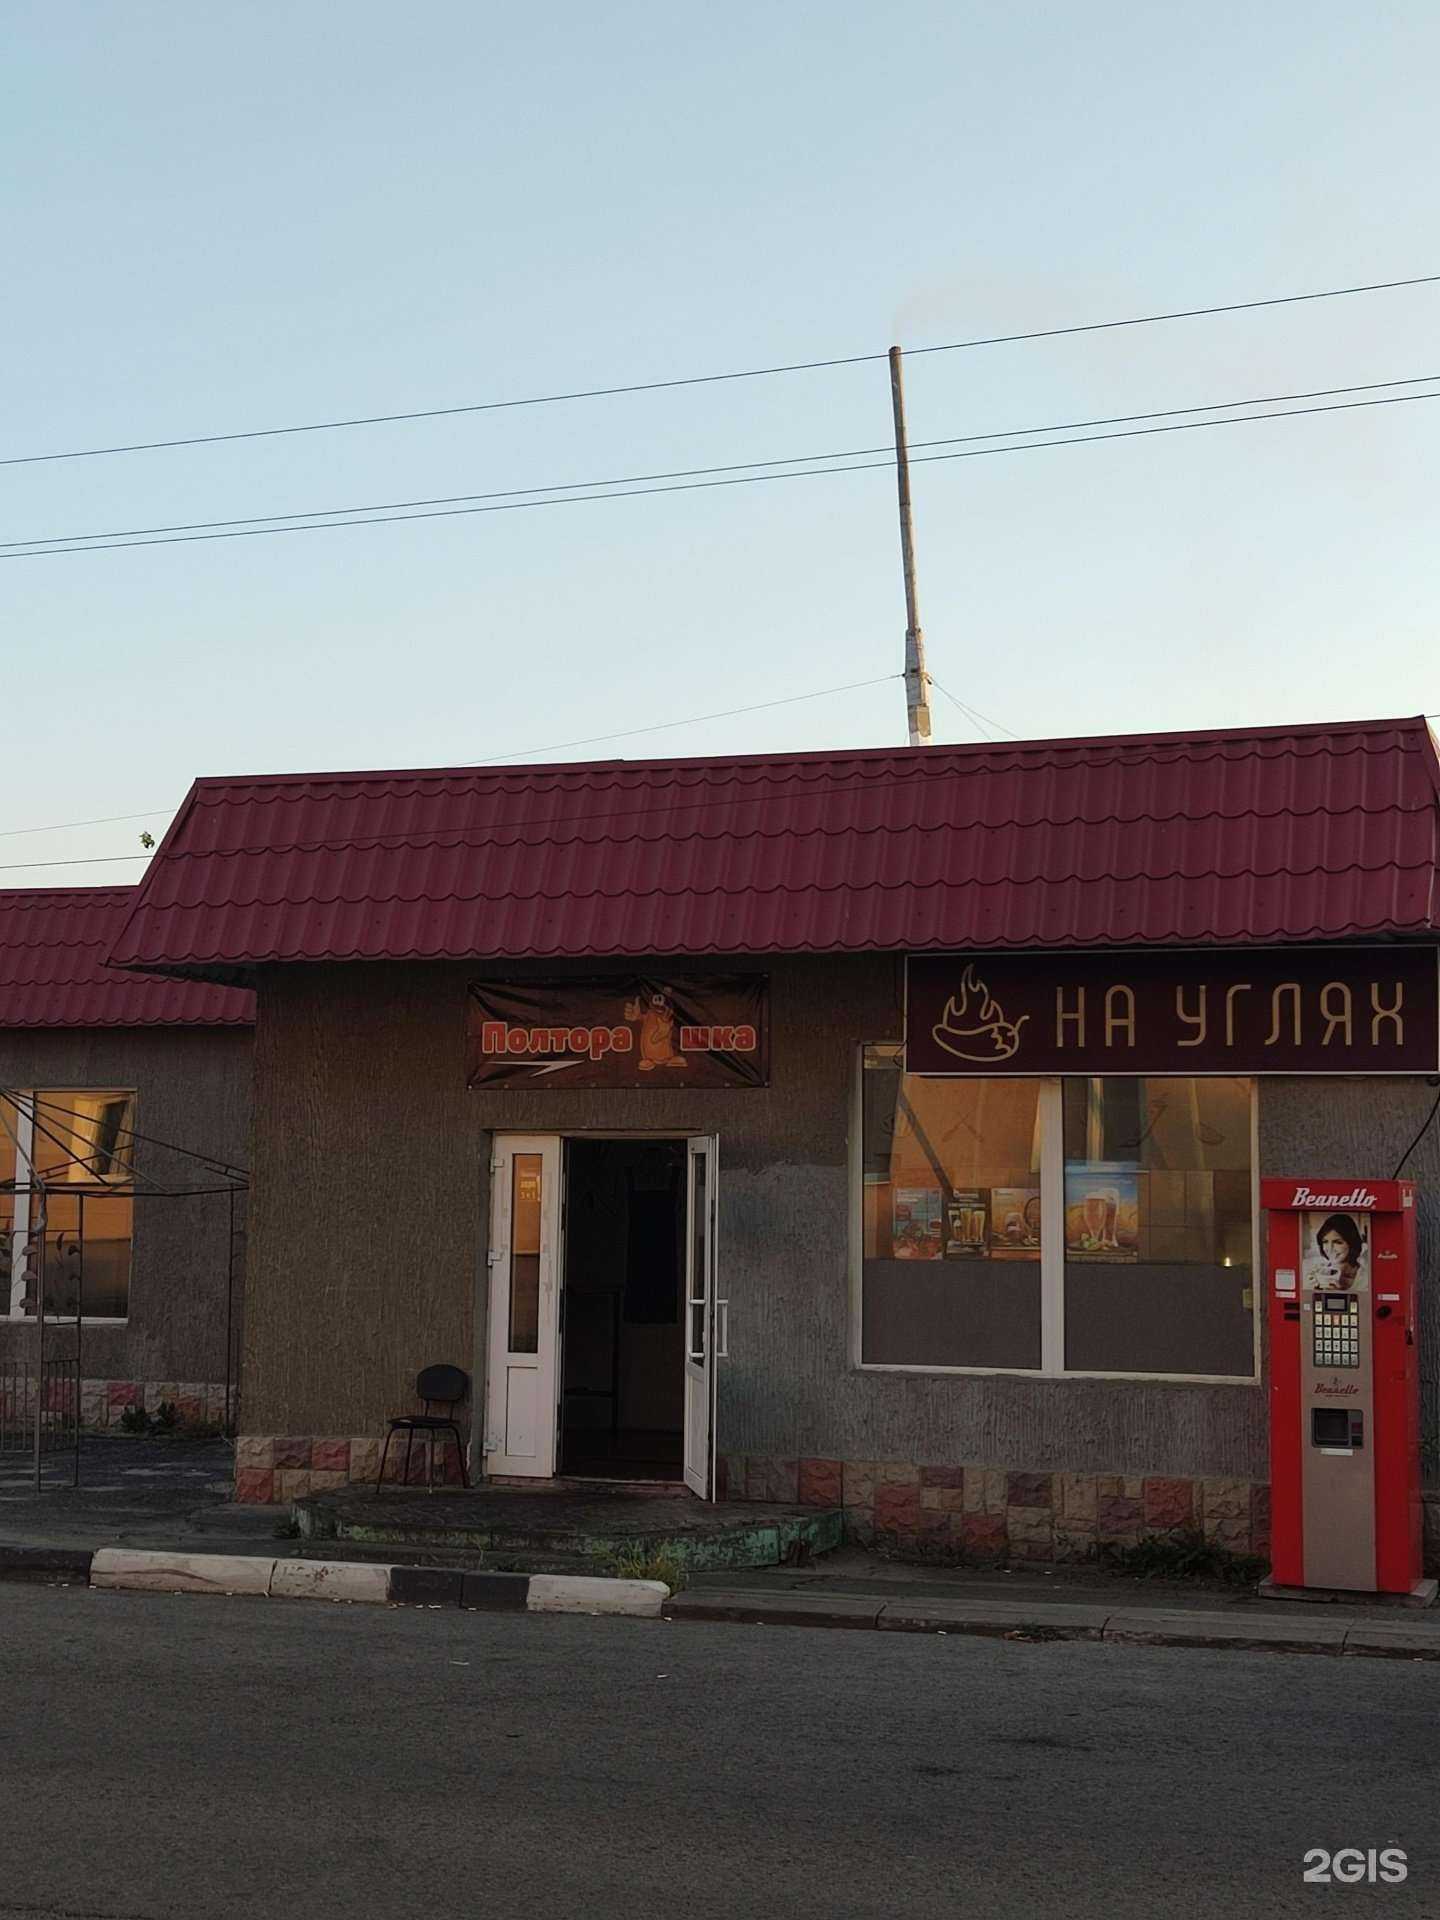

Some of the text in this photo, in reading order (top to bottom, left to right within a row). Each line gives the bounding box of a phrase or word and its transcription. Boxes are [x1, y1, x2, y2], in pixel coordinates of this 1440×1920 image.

[1056, 982, 1404, 1047] НА УГЛЯХ
[481, 1021, 757, 1061] Полтора шка
[1292, 1187, 1378, 1207] Beanello
